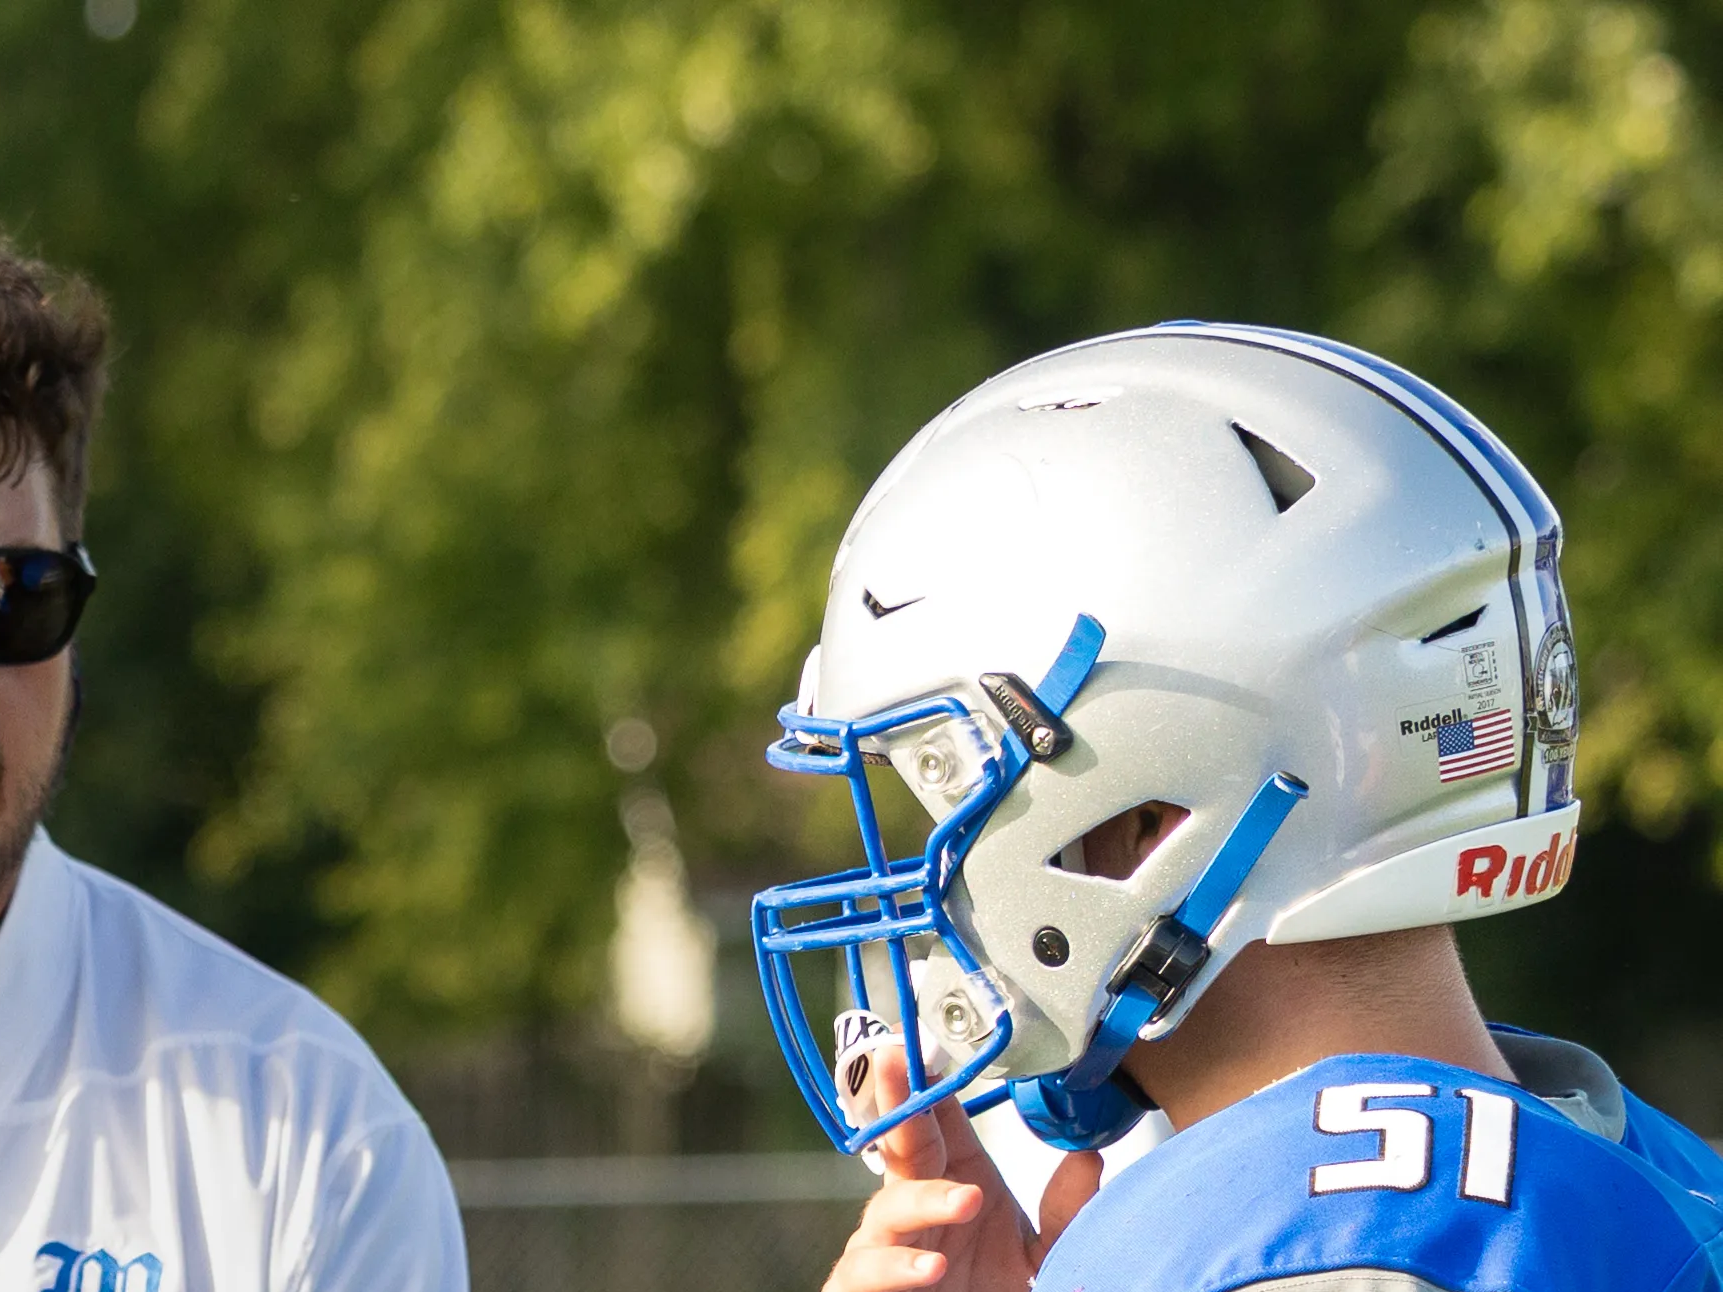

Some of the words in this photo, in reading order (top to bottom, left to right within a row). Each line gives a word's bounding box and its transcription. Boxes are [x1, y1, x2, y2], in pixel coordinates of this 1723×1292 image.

[1477, 699, 1495, 710] 2017
[1400, 708, 1463, 736] Riddell
[1308, 1082, 1520, 1209] 51
